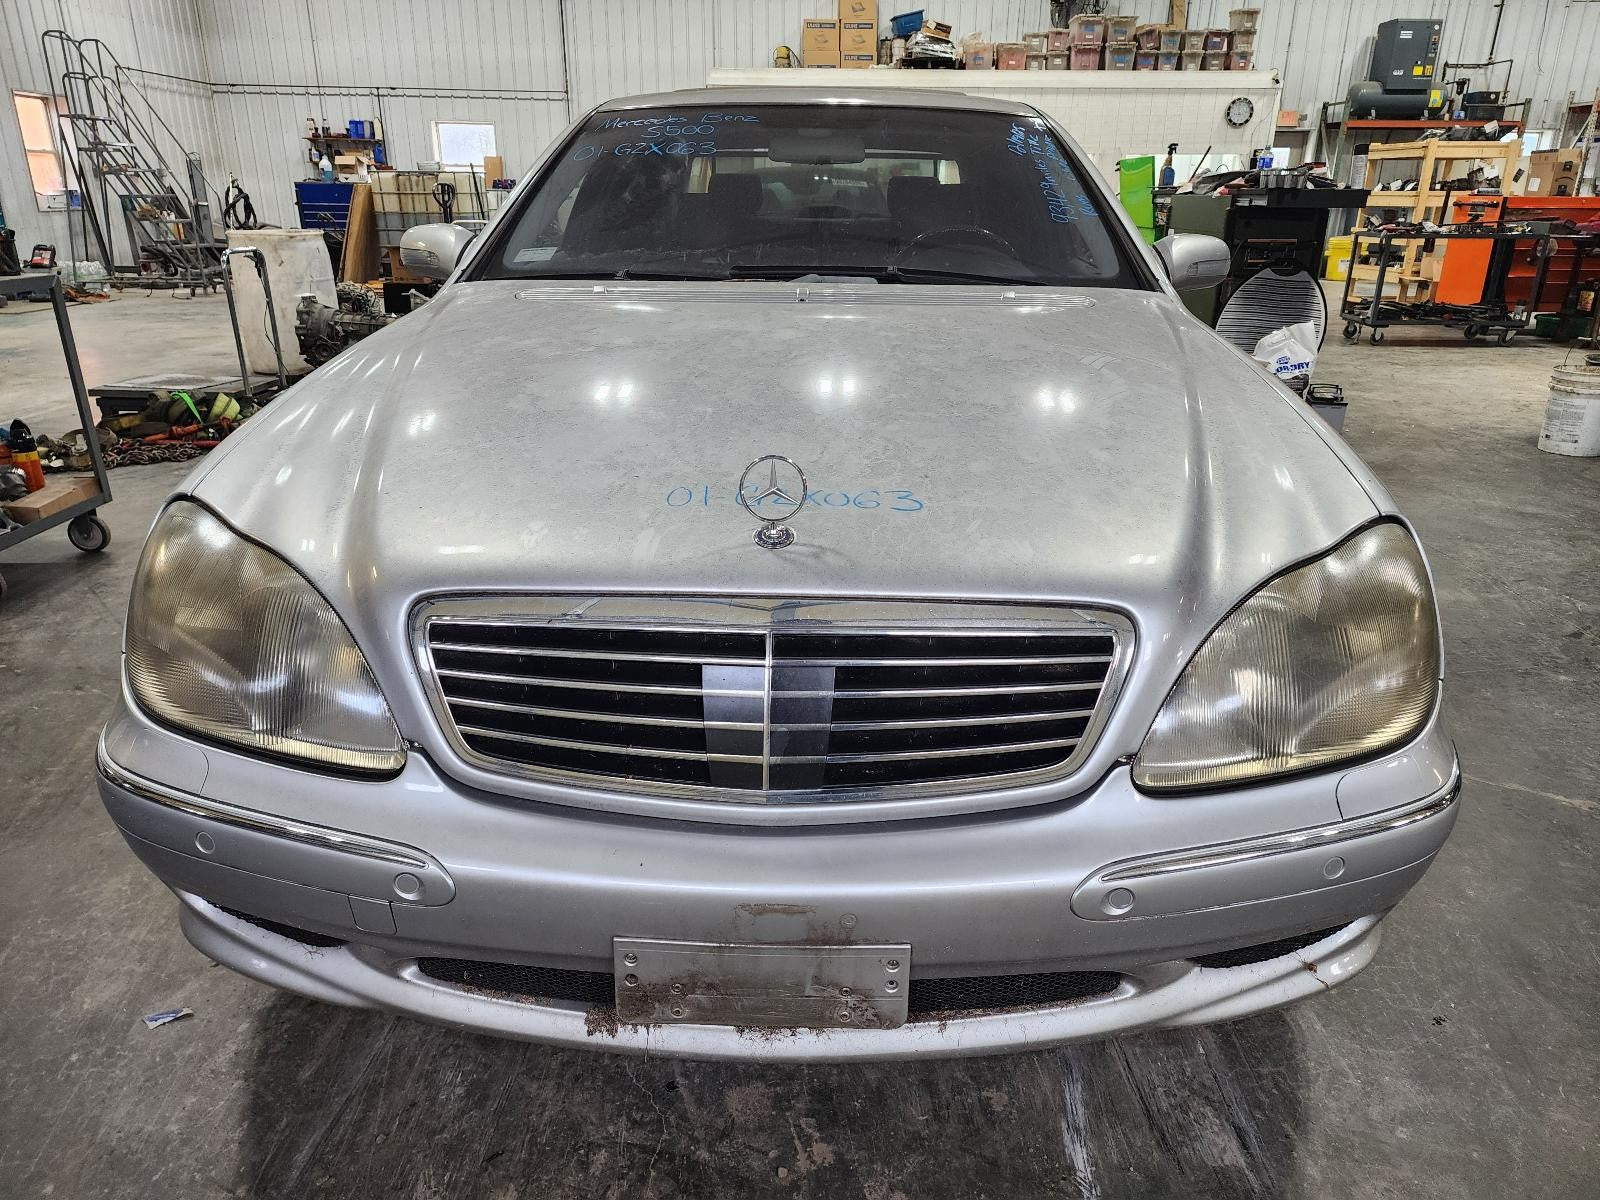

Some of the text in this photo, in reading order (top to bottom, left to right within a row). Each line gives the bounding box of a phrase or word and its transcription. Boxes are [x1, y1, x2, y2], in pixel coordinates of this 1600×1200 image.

[594, 112, 760, 132] Mercedes Benz
[641, 125, 715, 138] S500
